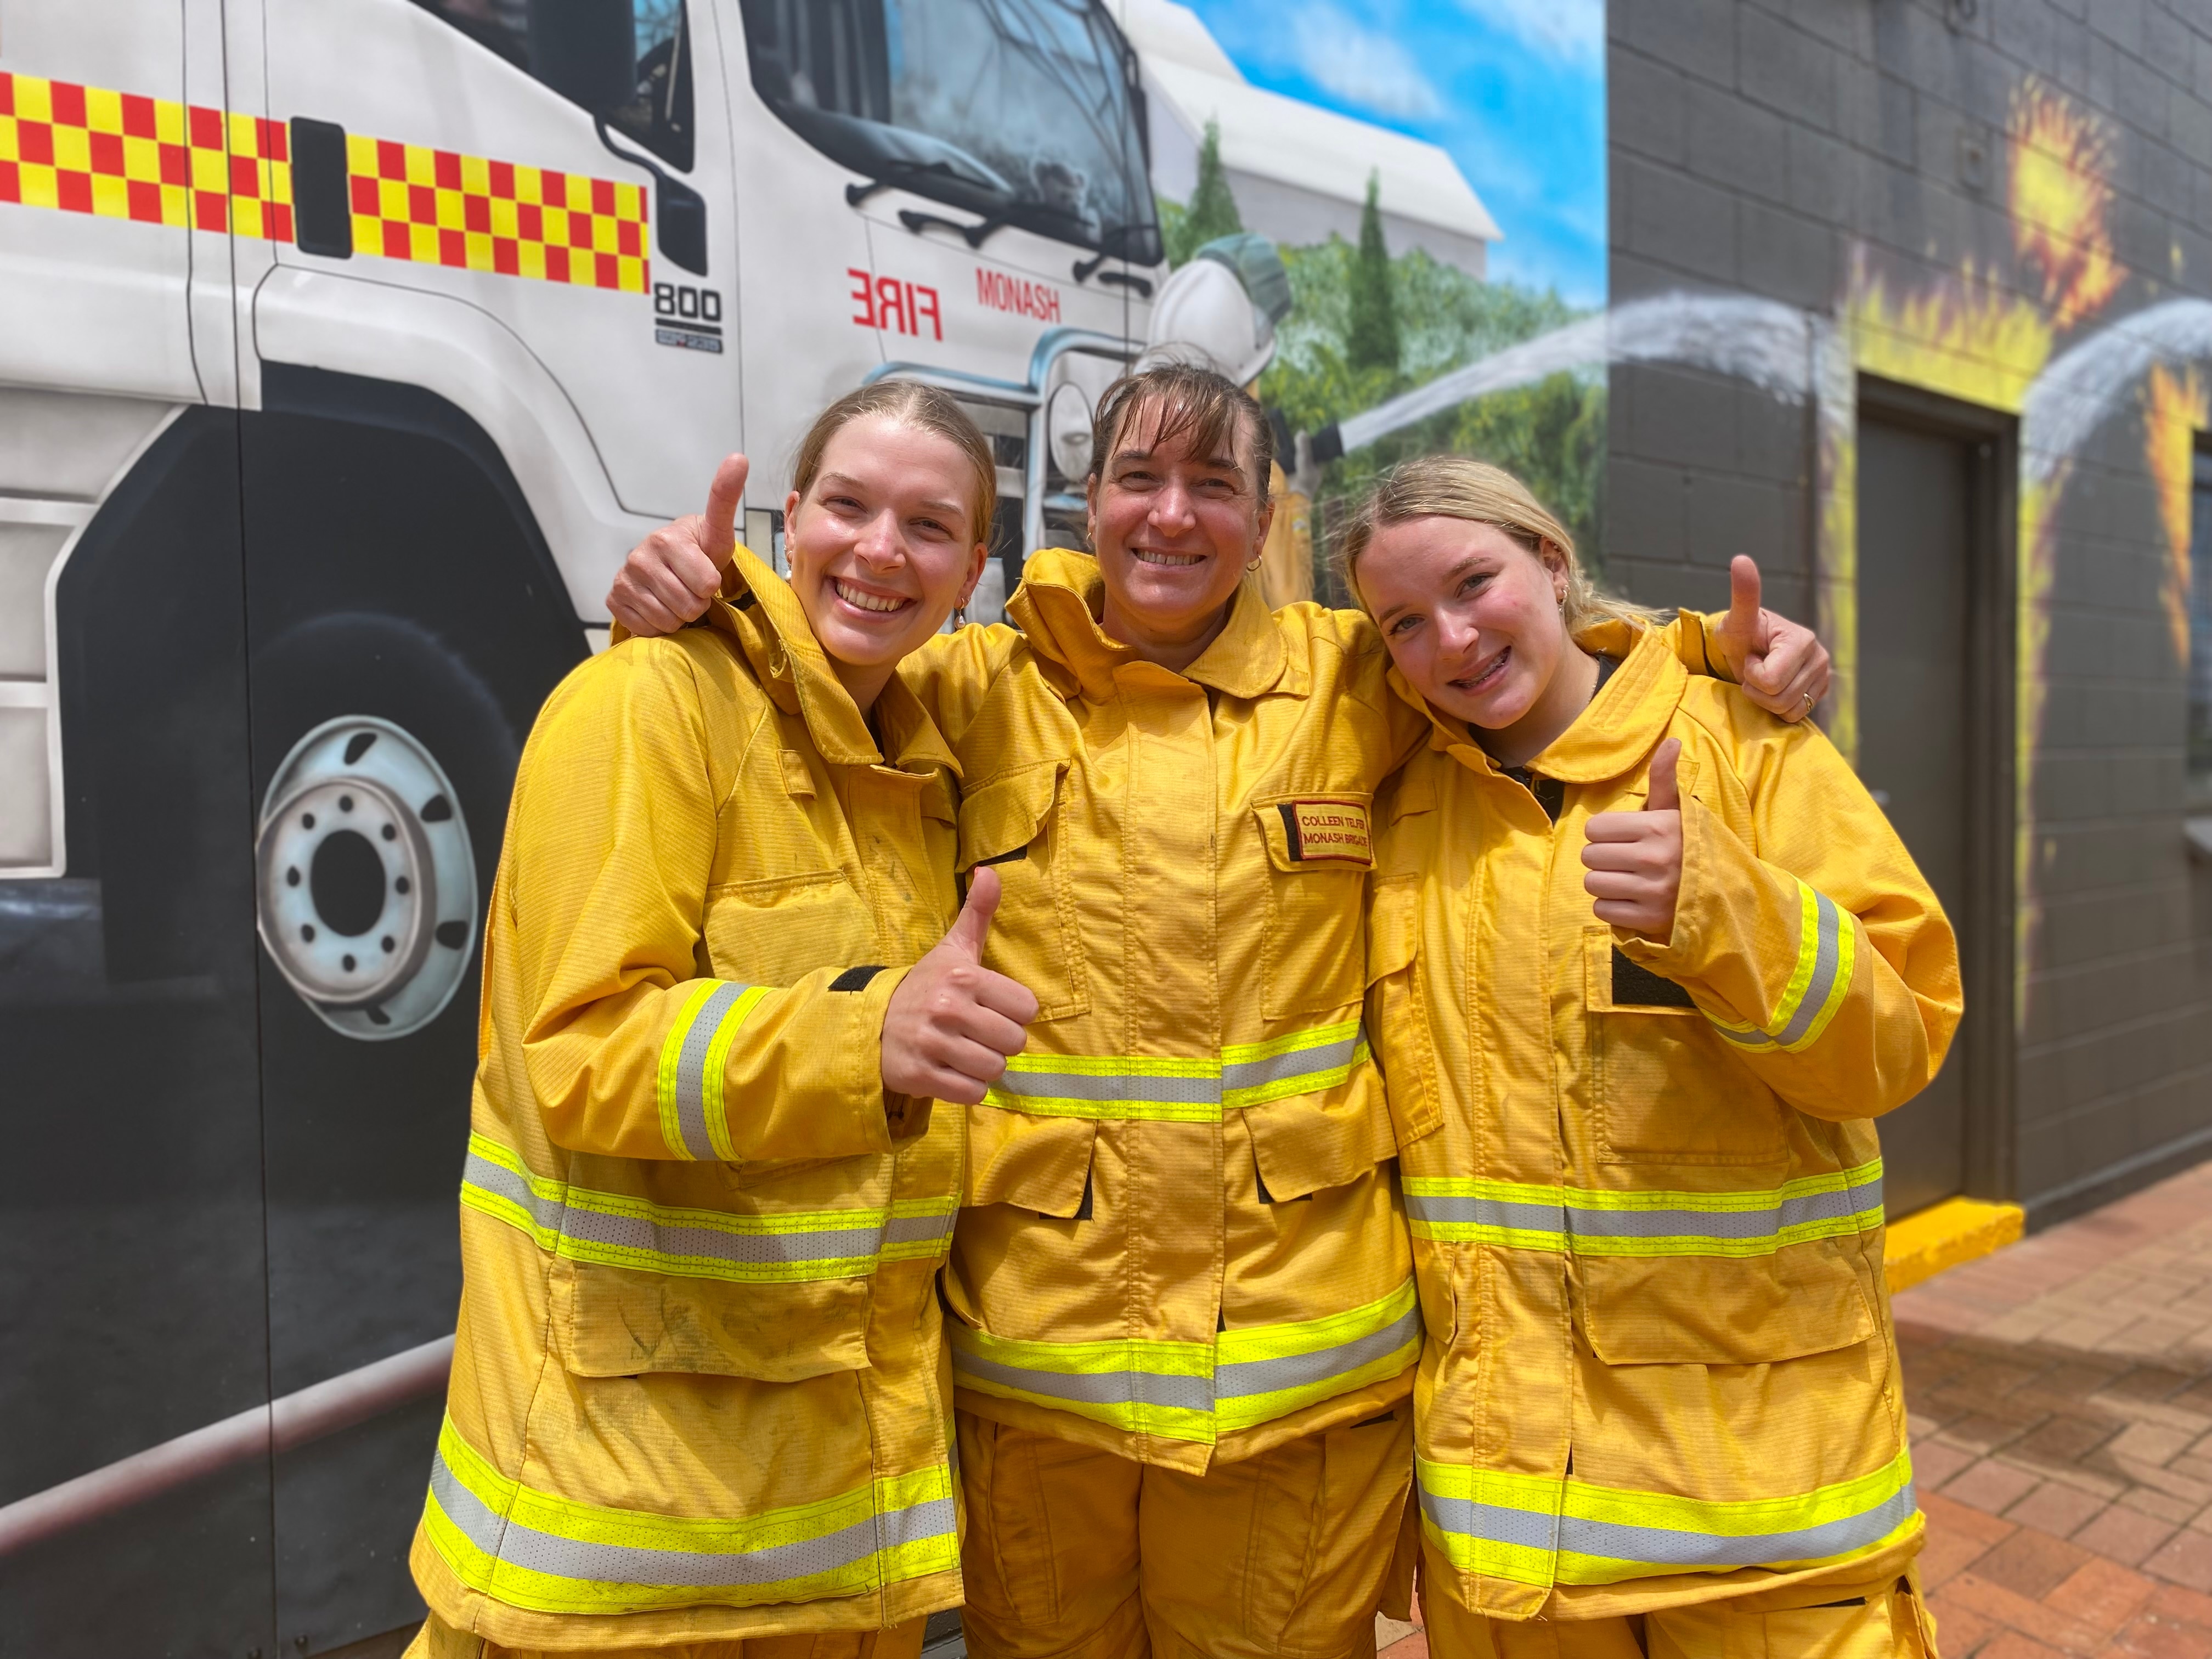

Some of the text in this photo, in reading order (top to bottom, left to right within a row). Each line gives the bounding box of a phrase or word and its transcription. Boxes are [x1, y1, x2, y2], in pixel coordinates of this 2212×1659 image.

[654, 283, 721, 321] 800
[977, 267, 1061, 324] MONASH
[1302, 816, 1344, 827] COLLEEN
[1303, 833, 1344, 844] MONASH
